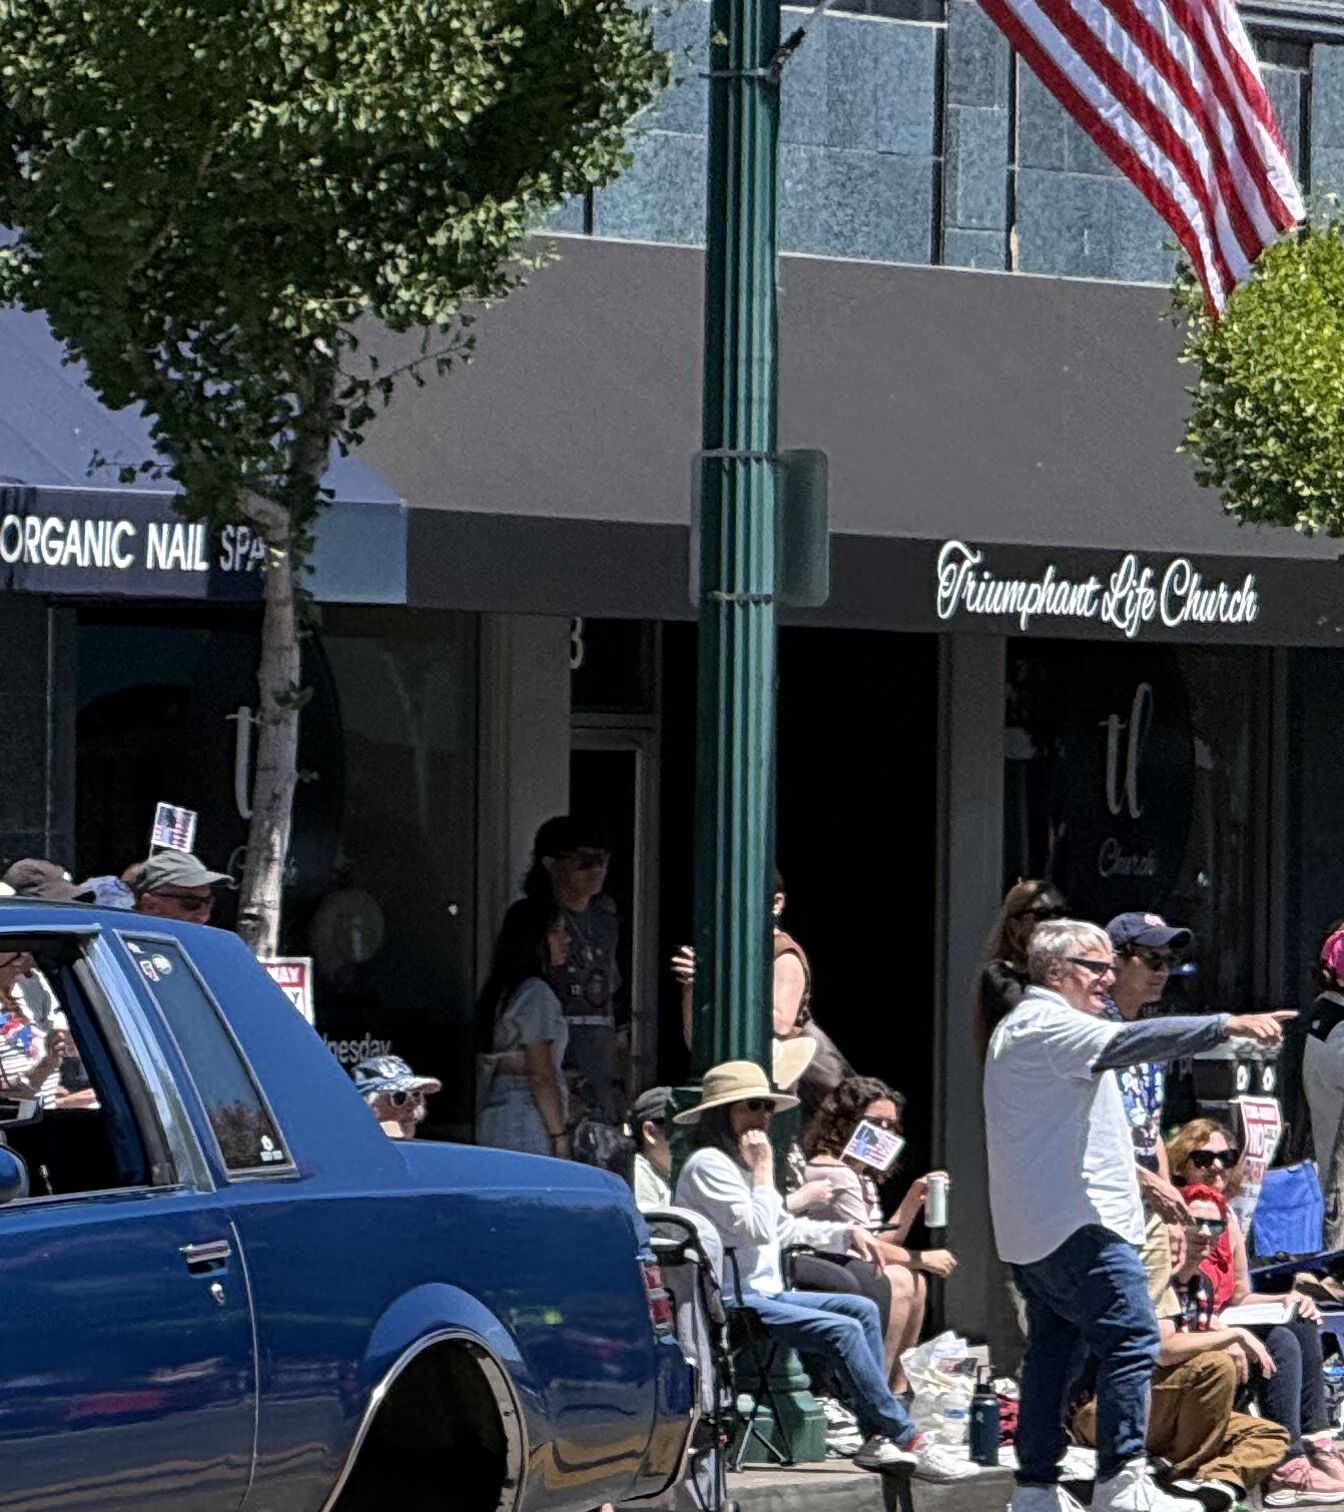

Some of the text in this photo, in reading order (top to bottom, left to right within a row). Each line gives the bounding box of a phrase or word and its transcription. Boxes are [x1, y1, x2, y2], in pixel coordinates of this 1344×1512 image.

[146, 521, 209, 572] NAIL
[936, 540, 1260, 639] Triumphant Life Church
